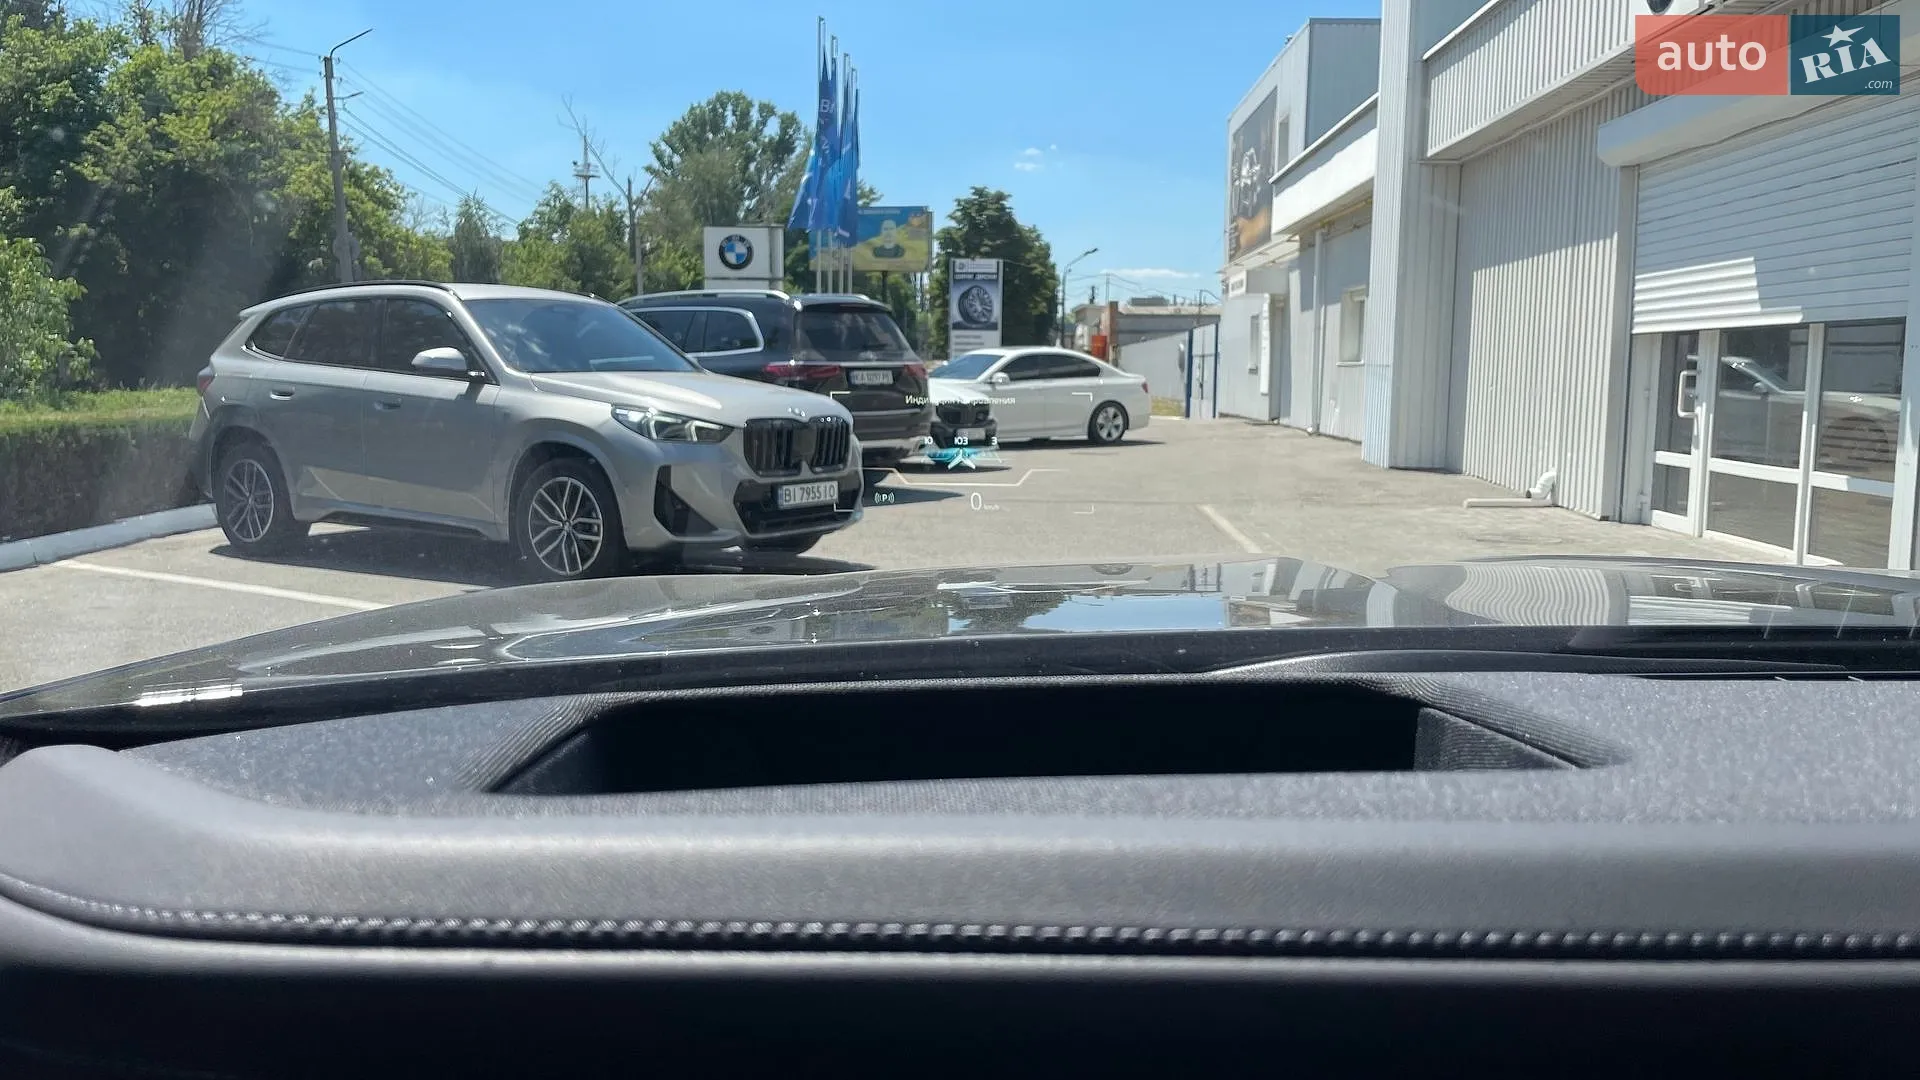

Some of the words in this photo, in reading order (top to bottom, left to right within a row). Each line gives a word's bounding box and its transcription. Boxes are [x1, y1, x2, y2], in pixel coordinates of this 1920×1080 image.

[905, 395, 954, 405] Индиция
[800, 485, 822, 501] 7955
[970, 492, 982, 510] 0
